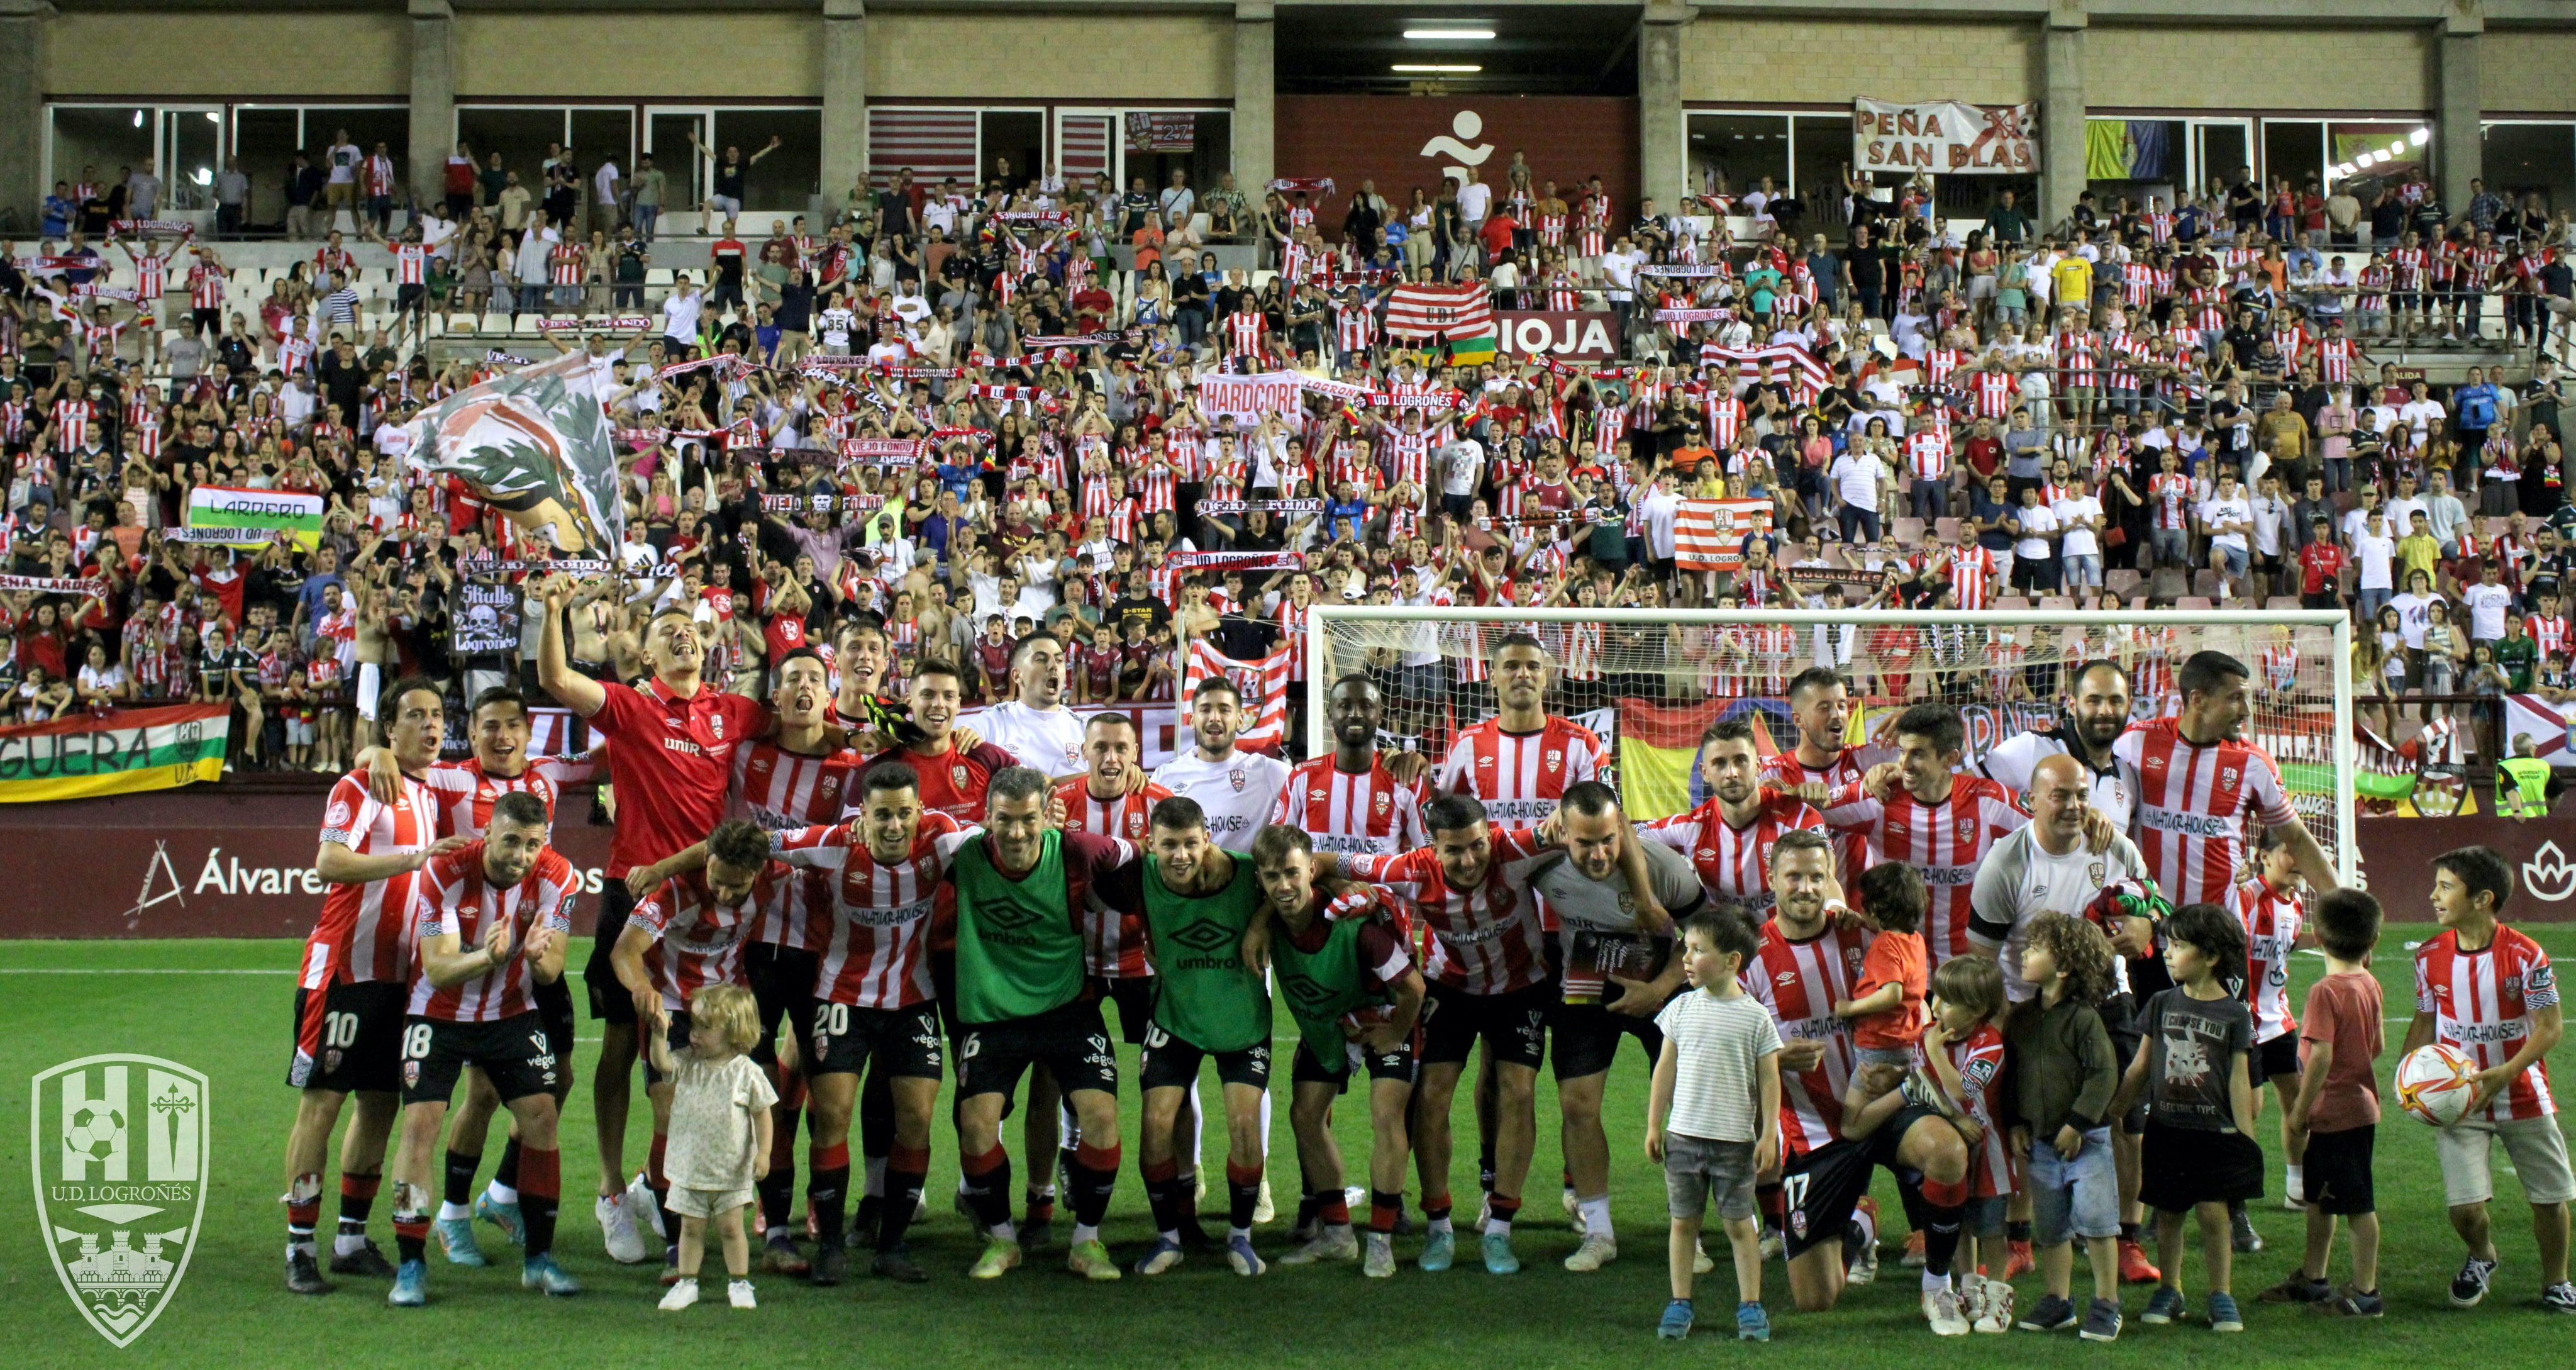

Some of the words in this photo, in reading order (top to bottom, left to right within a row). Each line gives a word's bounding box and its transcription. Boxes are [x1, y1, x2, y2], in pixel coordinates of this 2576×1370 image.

[1162, 124, 1189, 140] 27
[1857, 111, 1943, 137] PEÑA
[1869, 143, 1933, 167] SAN
[1948, 144, 2030, 167] BLAS
[1665, 311, 1675, 320] UD
[828, 320, 843, 330] 85
[1206, 382, 1296, 413] HARDCORE
[1374, 394, 1389, 405] UD
[850, 443, 877, 452] VIEJO
[763, 495, 802, 510] VIEJO
[246, 528, 260, 539] UD
[1196, 554, 1211, 566] UD
[462, 584, 513, 604] Skulls
[1519, 801, 1548, 820] HOUSE
[1211, 816, 1241, 831] HOUSE
[2151, 811, 2186, 833] NATUR
[2187, 816, 2218, 837] HOUSE
[1317, 835, 1349, 852] NATUR
[1351, 837, 1378, 853] HOUSE
[1933, 869, 1963, 885] HOUSE
[897, 902, 930, 922] HOUSE
[1476, 922, 1507, 942] HOUSE
[1176, 951, 1236, 969] umbro
[813, 1003, 848, 1035] 20
[325, 1011, 358, 1048] 10
[2204, 1022, 2223, 1035] YOU
[2481, 1022, 2518, 1041] HOUSE
[401, 1024, 432, 1059] 18
[2197, 1106, 2216, 1115] TYPE
[1784, 1172, 1809, 1213] 17
